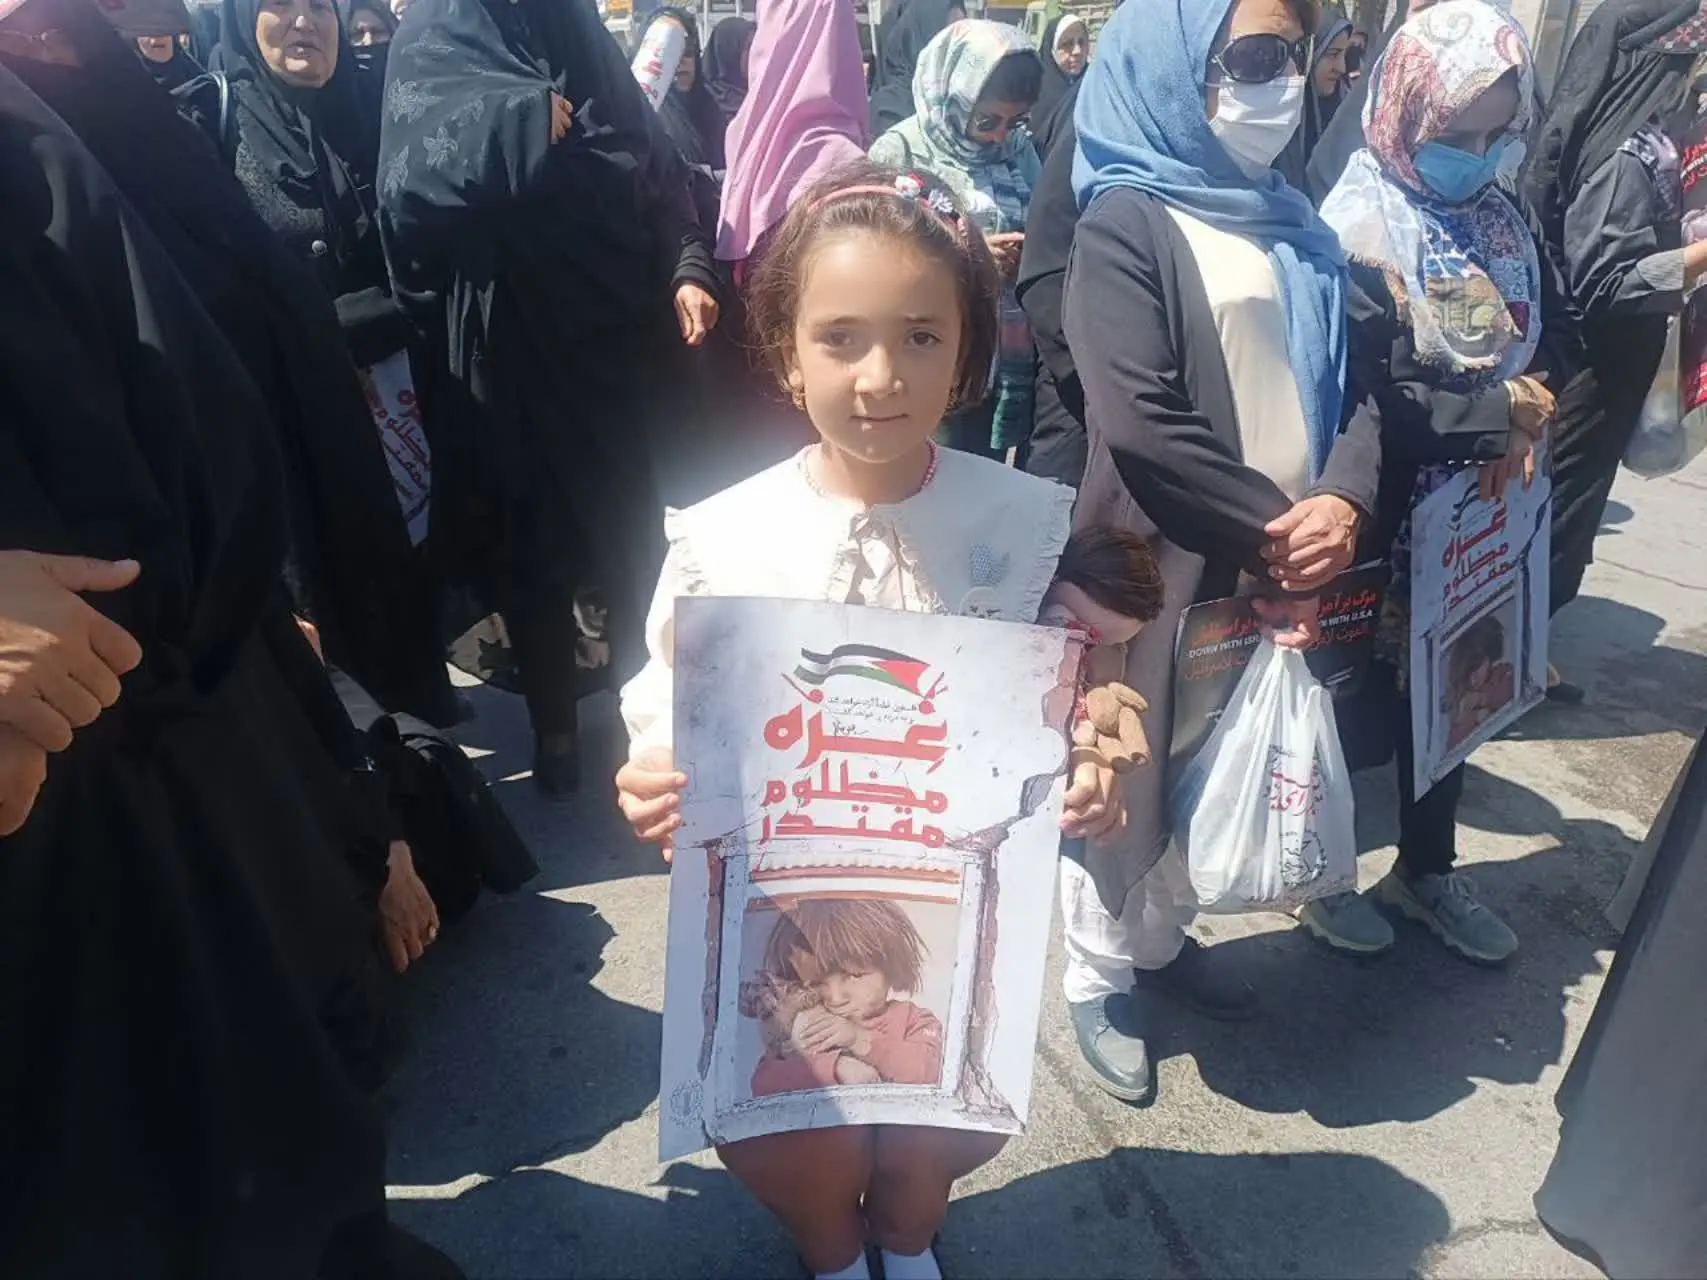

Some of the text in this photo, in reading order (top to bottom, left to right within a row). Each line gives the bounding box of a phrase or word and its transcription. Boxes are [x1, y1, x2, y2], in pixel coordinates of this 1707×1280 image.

[1329, 613, 1351, 627] WITH
[1189, 644, 1219, 658] DOWN
[1219, 638, 1243, 651] WITH
[763, 687, 949, 774] غزه
[760, 758, 949, 814] مظلوم
[758, 804, 945, 849] مقتدر
